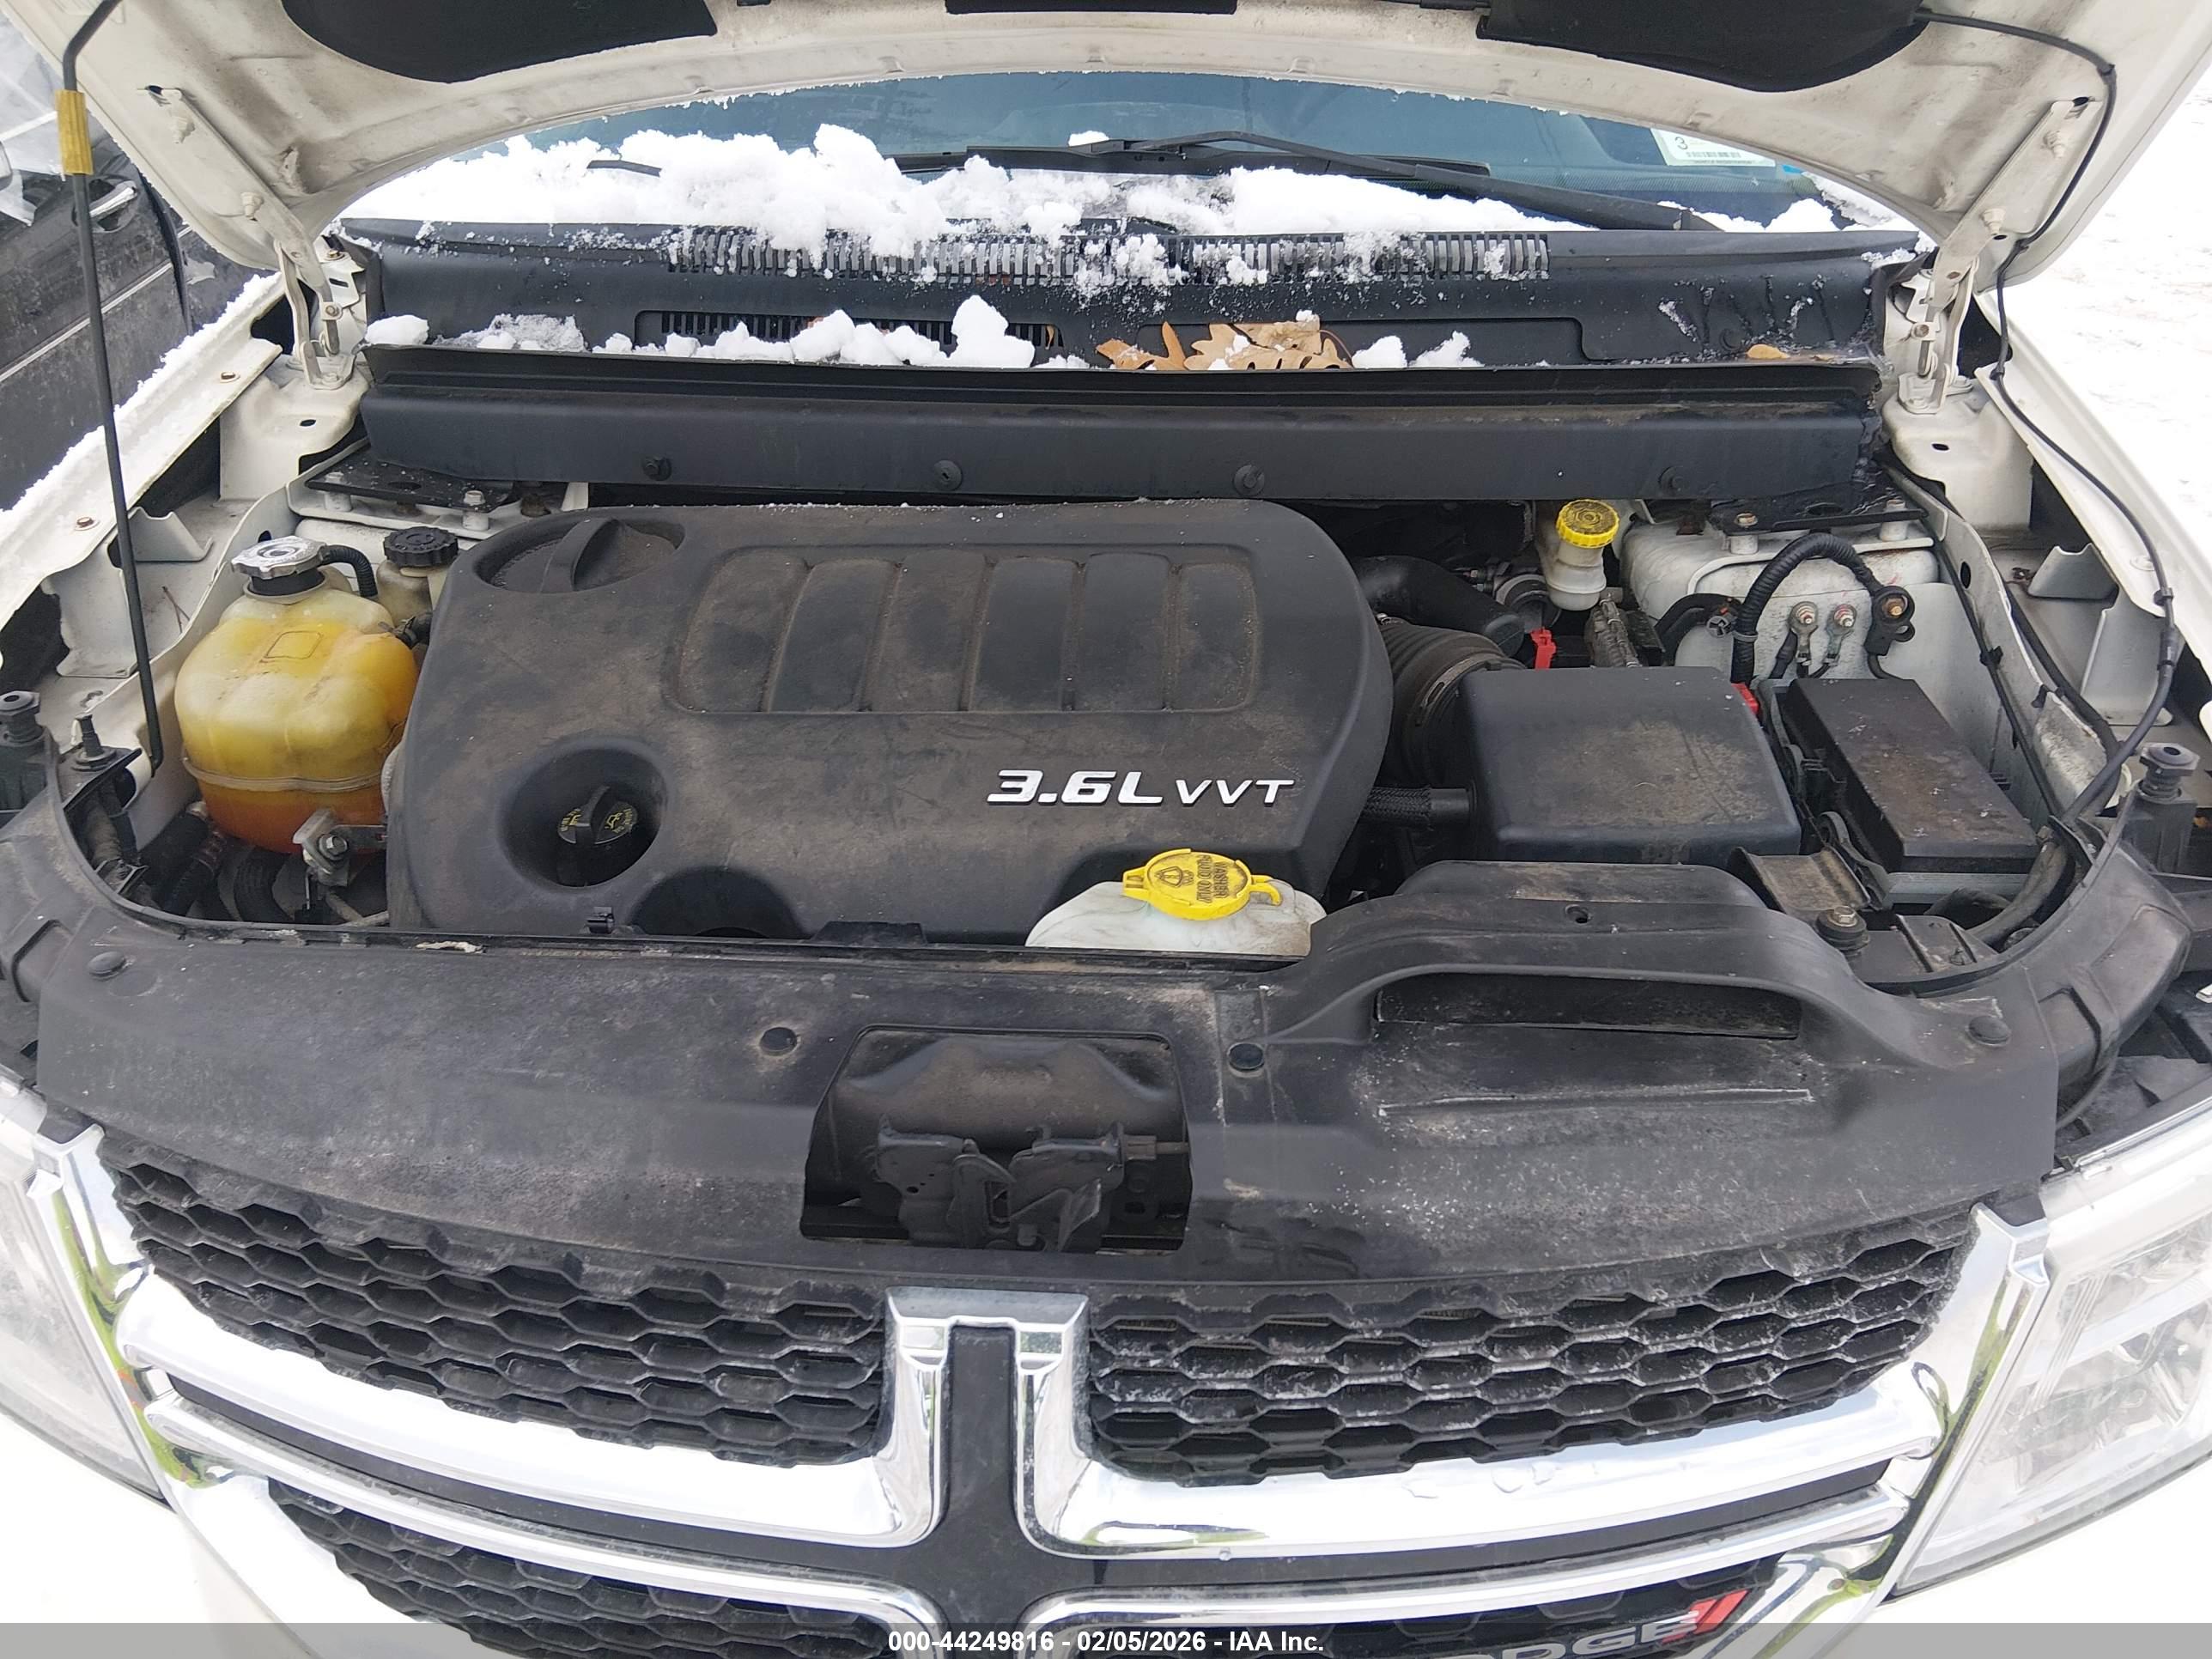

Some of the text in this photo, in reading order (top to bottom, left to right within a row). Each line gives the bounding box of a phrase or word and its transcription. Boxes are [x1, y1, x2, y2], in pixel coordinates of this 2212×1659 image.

[1674, 137, 1688, 150] 3
[987, 769, 1295, 805] 3.6L VVT
[1196, 881, 1212, 903] ONLY
[1214, 862, 1229, 899] WASHER
